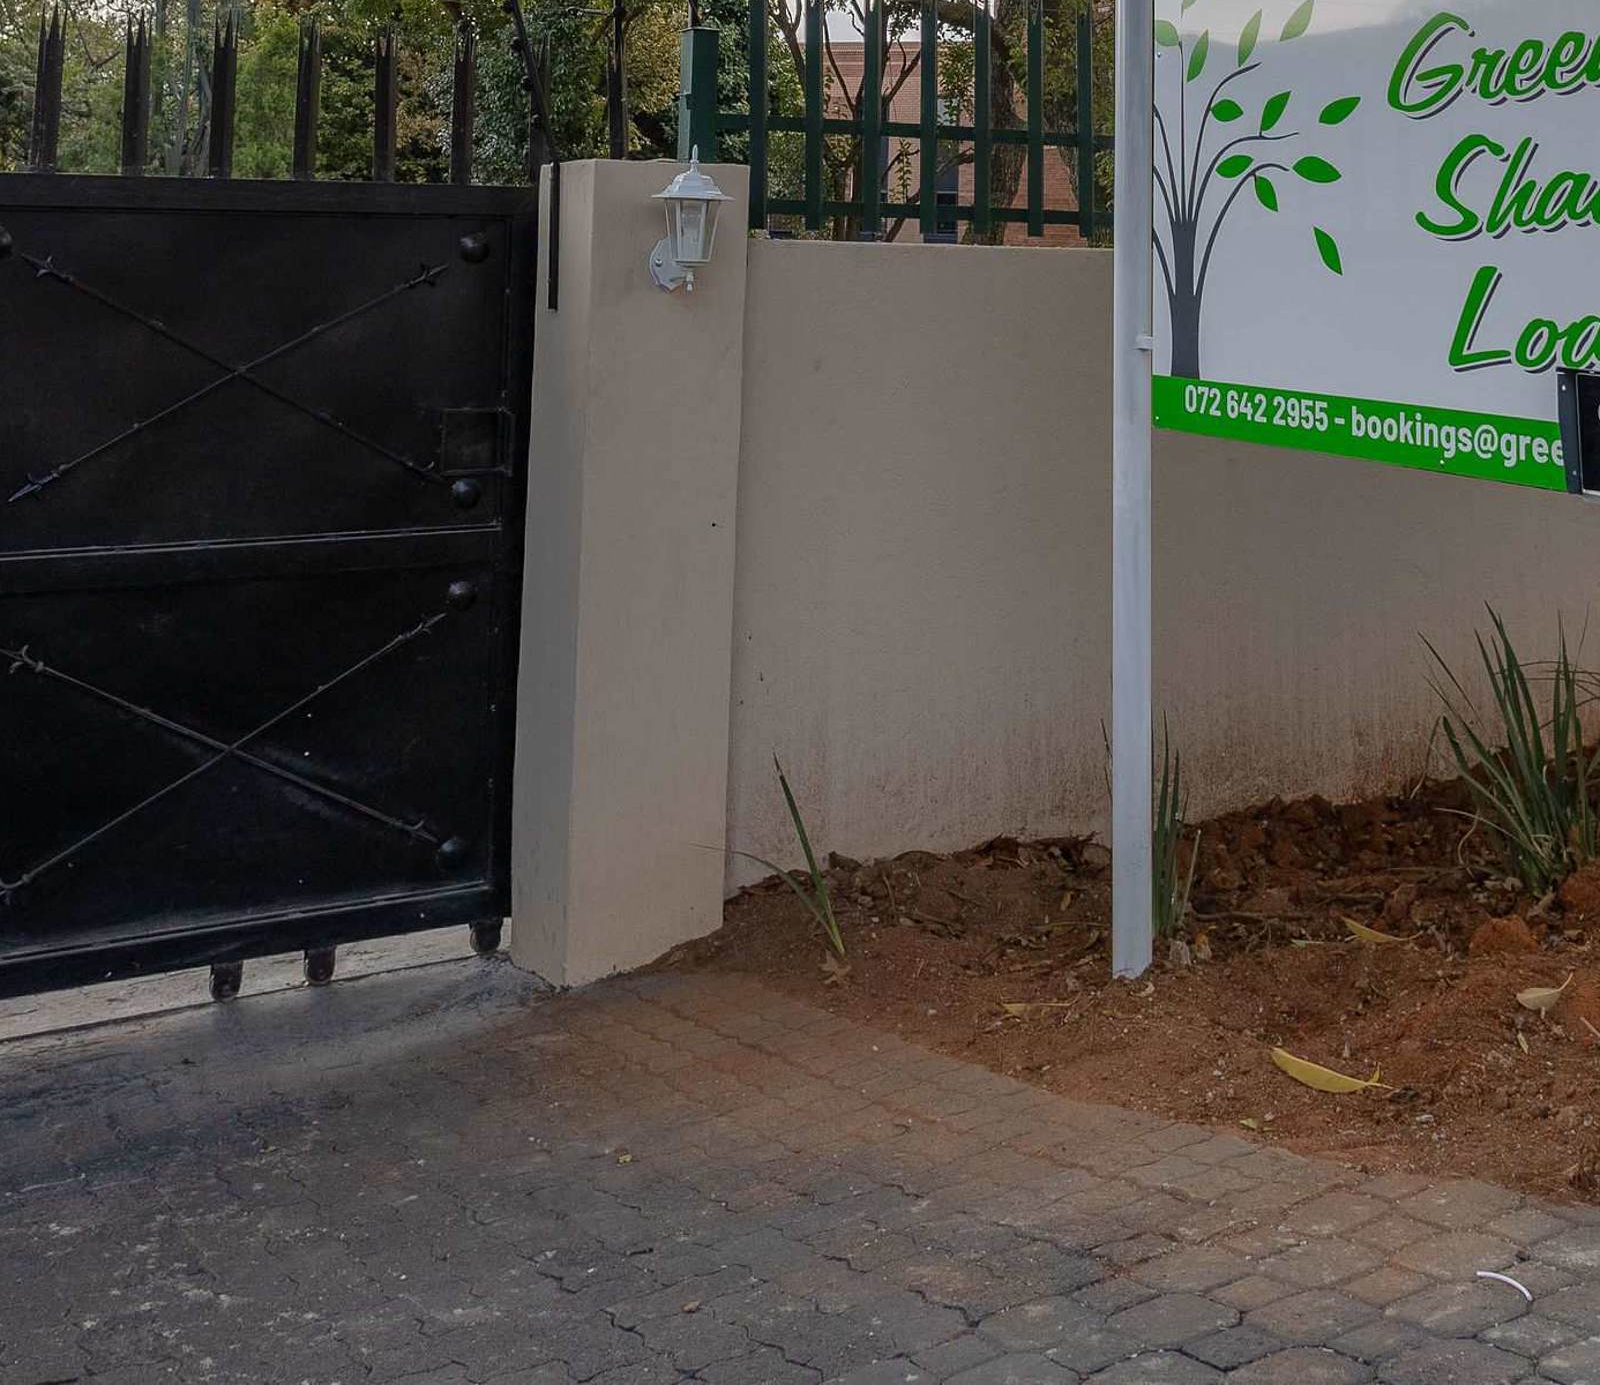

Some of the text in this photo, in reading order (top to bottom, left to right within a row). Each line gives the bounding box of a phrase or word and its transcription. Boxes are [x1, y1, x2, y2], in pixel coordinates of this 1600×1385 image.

[1387, 12, 1600, 120] Gree
[1415, 133, 1600, 242] Sha
[1185, 384, 1221, 416] 072
[1226, 390, 1267, 423] 642
[1273, 396, 1328, 432] 2955
[1351, 405, 1564, 468] bookings@gree
